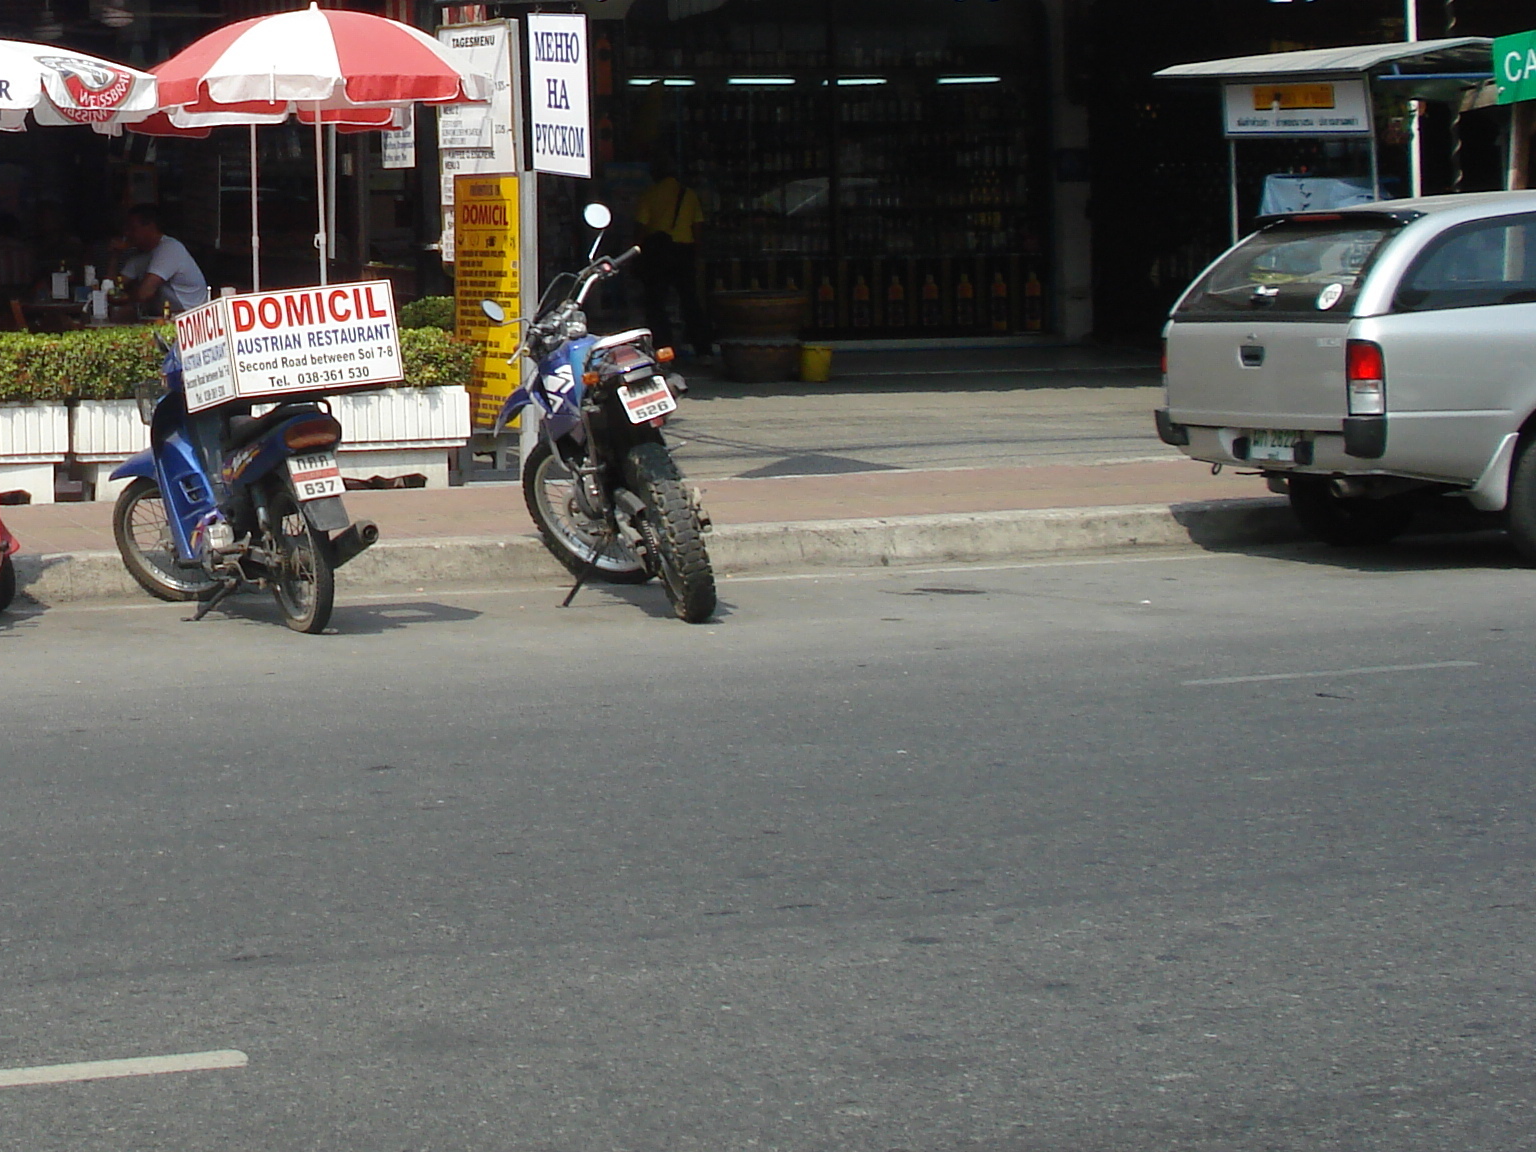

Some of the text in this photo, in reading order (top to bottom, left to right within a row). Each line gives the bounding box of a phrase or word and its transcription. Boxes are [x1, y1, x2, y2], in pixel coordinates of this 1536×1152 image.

[452, 34, 495, 48] TAGESMENU
[534, 31, 580, 64] МЕНЮ
[546, 78, 570, 110] НА
[535, 123, 585, 158] РУССКОМ
[462, 204, 510, 226] DOMICIL
[232, 286, 388, 333] DOMICIL
[178, 304, 224, 351] DOMICIL
[237, 323, 392, 356] AUSTRIAN RESTAURANT
[239, 346, 394, 373] Second Road between Soi 7-8
[269, 366, 370, 388] Tel. 038-361 530
[636, 400, 669, 420] 526
[304, 480, 335, 496] 637
